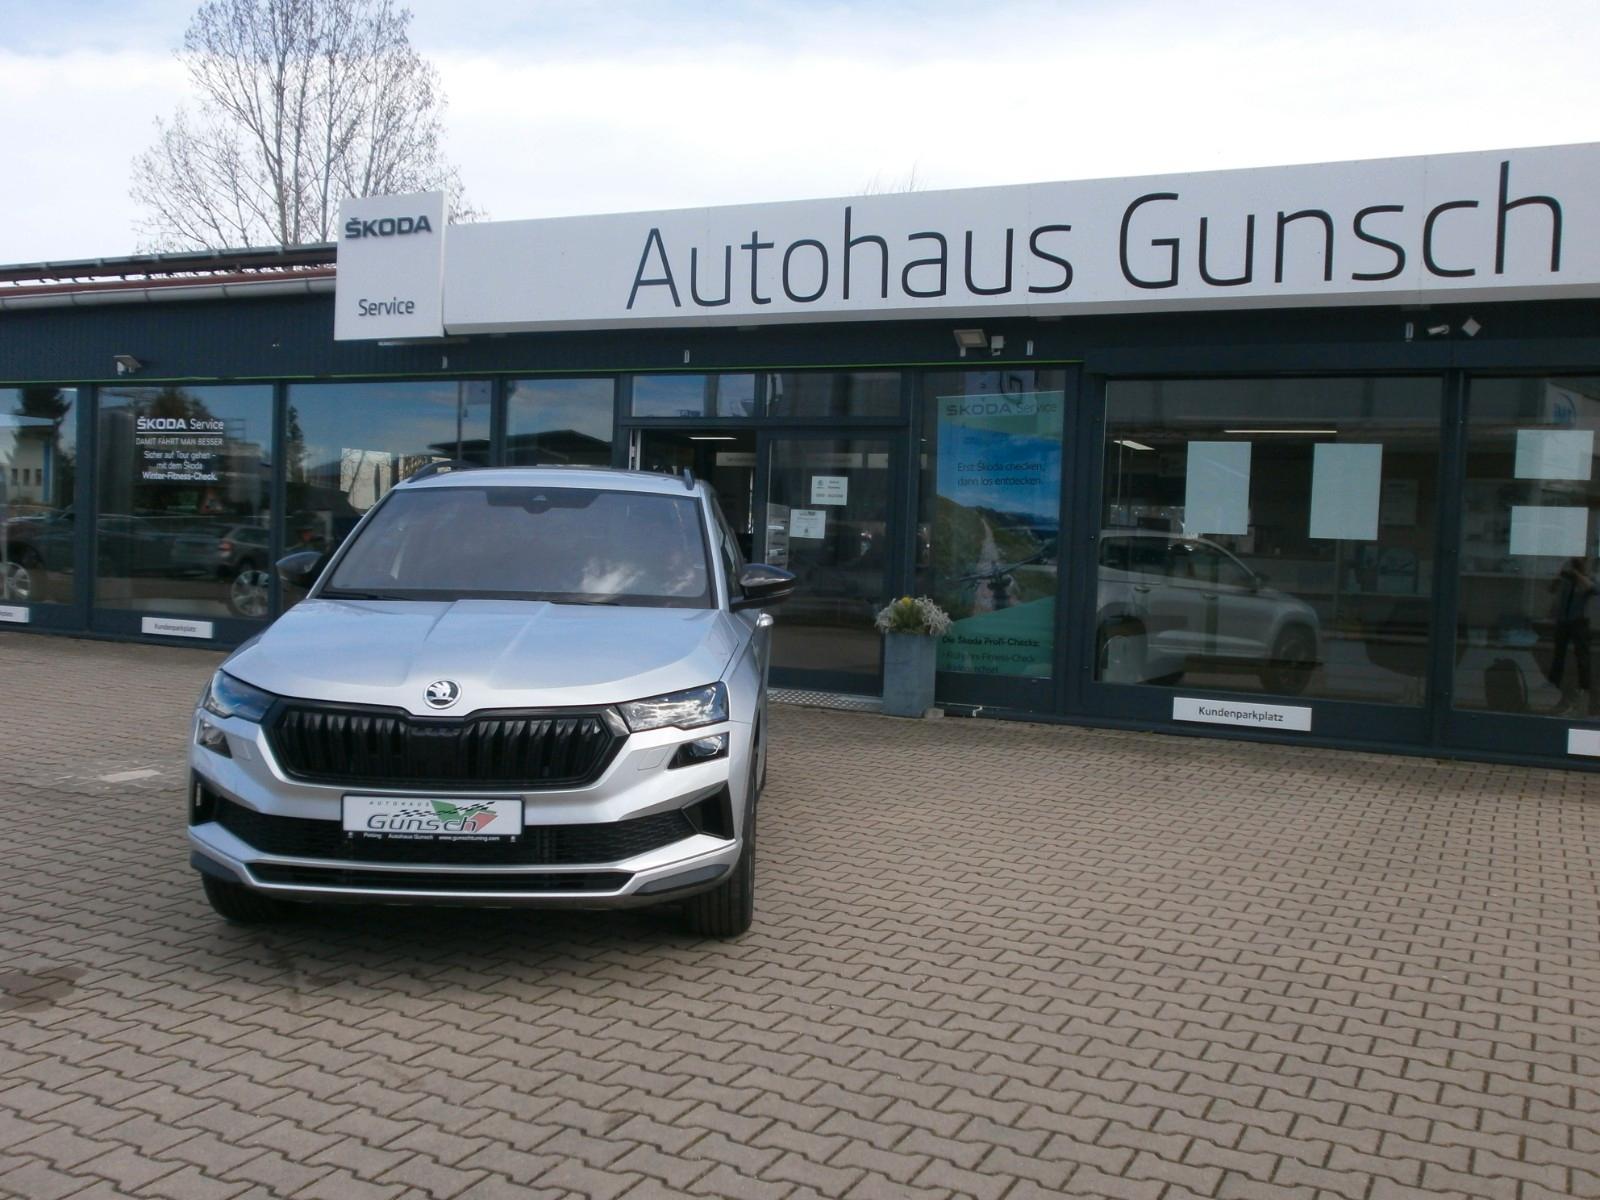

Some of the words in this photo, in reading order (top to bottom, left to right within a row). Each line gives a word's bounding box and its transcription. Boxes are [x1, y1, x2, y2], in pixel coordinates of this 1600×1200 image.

[345, 215, 432, 239] ŠKODA
[626, 206, 1074, 310] Autohaus
[1119, 160, 1563, 290] Gunsch
[358, 297, 415, 317] Service
[136, 416, 187, 430] ŠKODA
[190, 418, 224, 430] Service
[136, 437, 156, 446] DAMIT
[180, 438, 196, 446] MAN
[197, 438, 223, 446] BESSER
[143, 450, 162, 459] Sicher
[164, 450, 174, 459] auf
[176, 450, 190, 459] Tour
[1198, 706, 1284, 722] Kundenparkplatz
